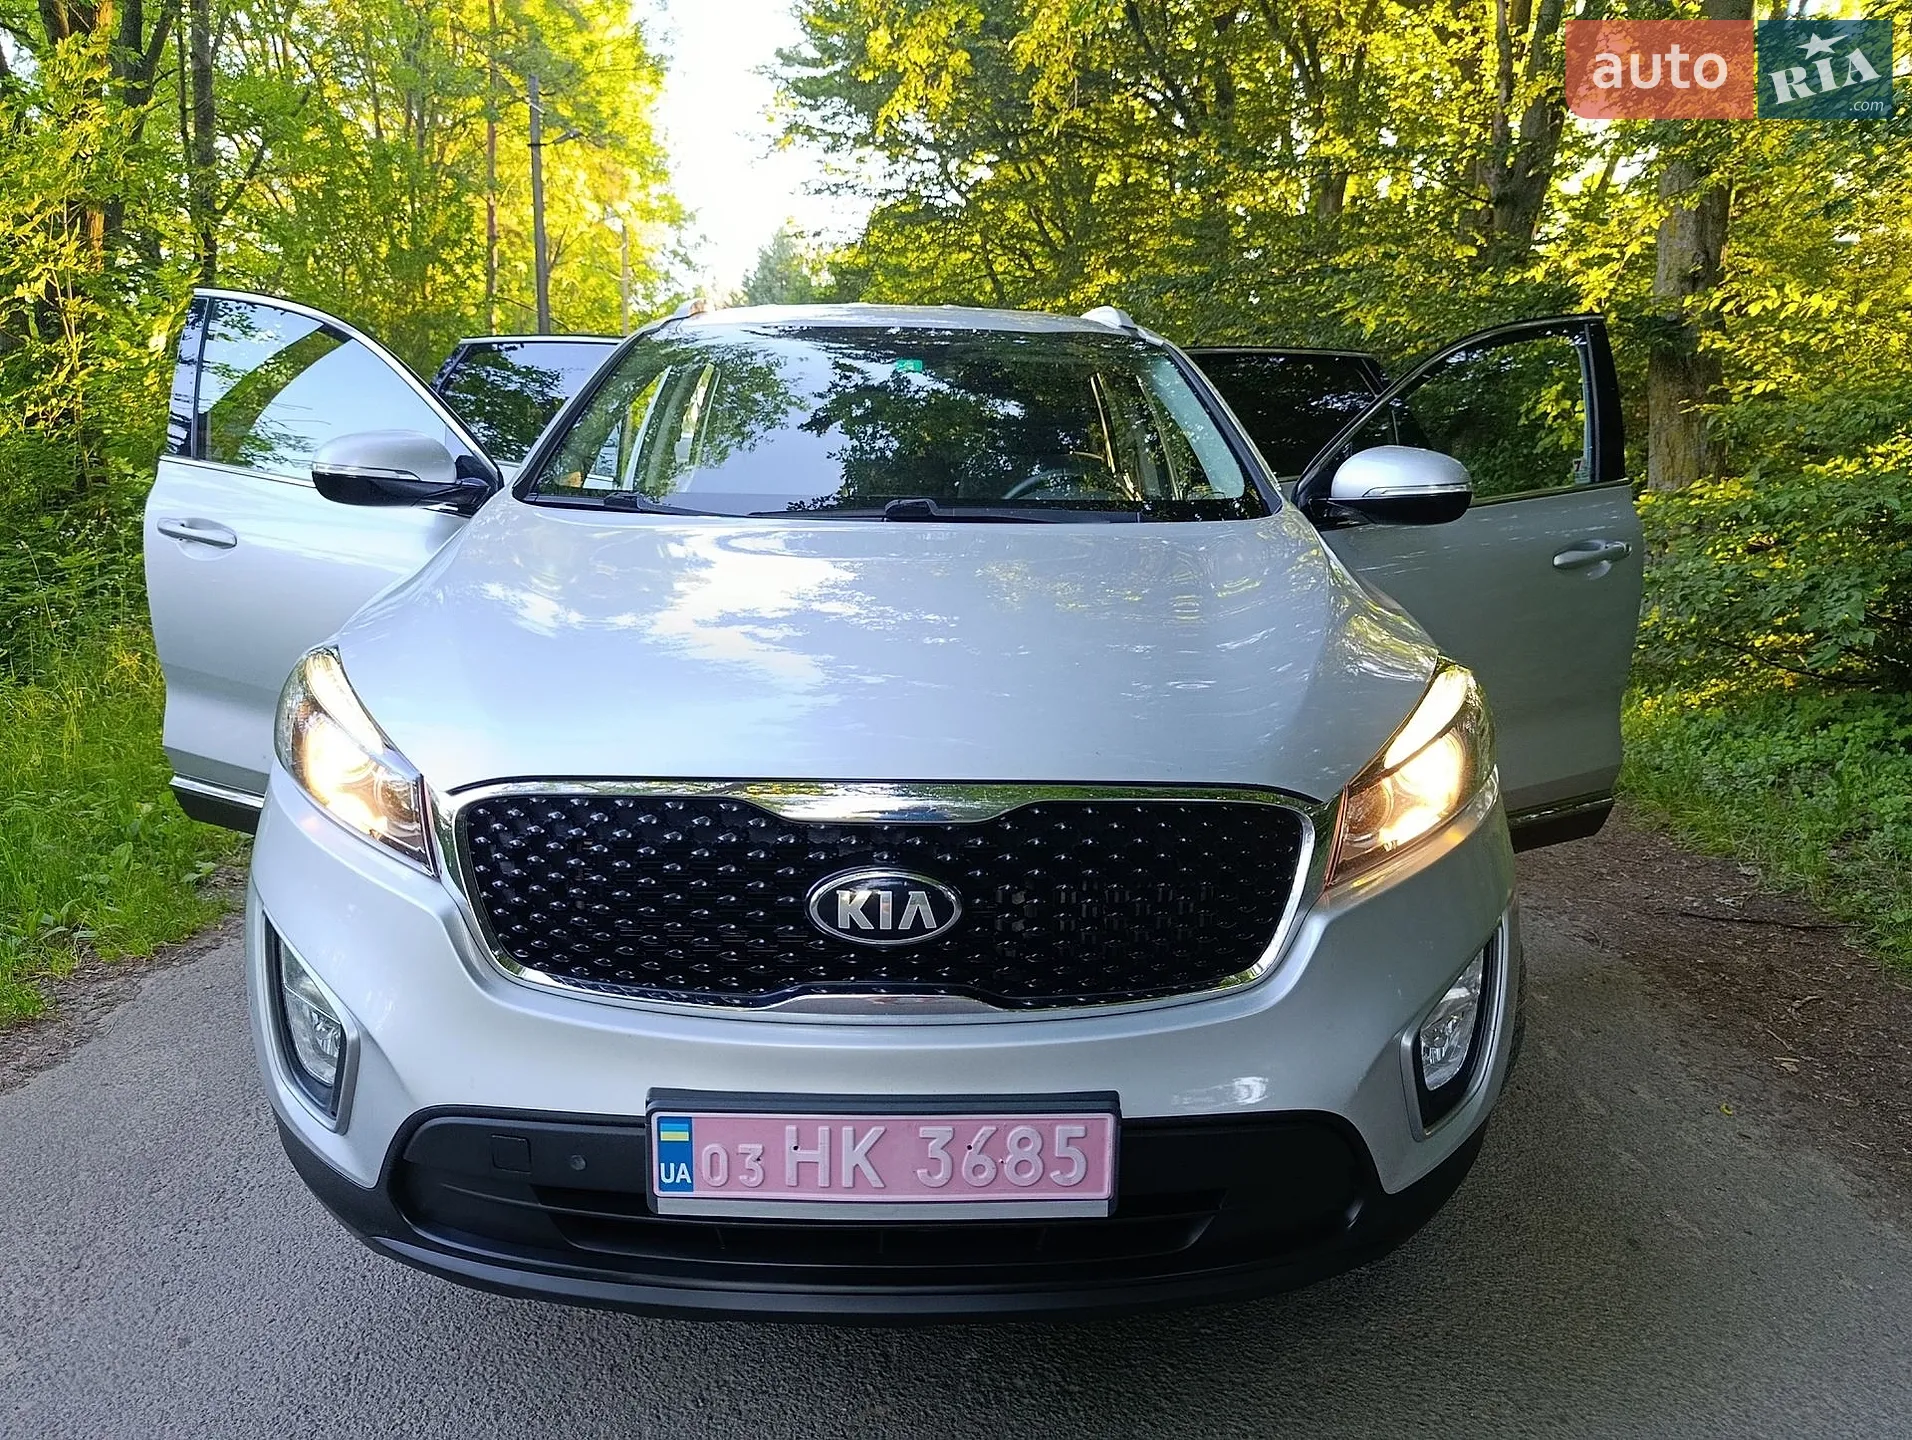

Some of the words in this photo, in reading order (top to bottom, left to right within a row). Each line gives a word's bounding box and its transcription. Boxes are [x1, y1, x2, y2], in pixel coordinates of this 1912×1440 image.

[837, 890, 937, 930] KIA
[660, 1163, 692, 1184] UA
[701, 1143, 765, 1188] 03
[785, 1125, 886, 1189] HK
[916, 1125, 1088, 1188] 3685
